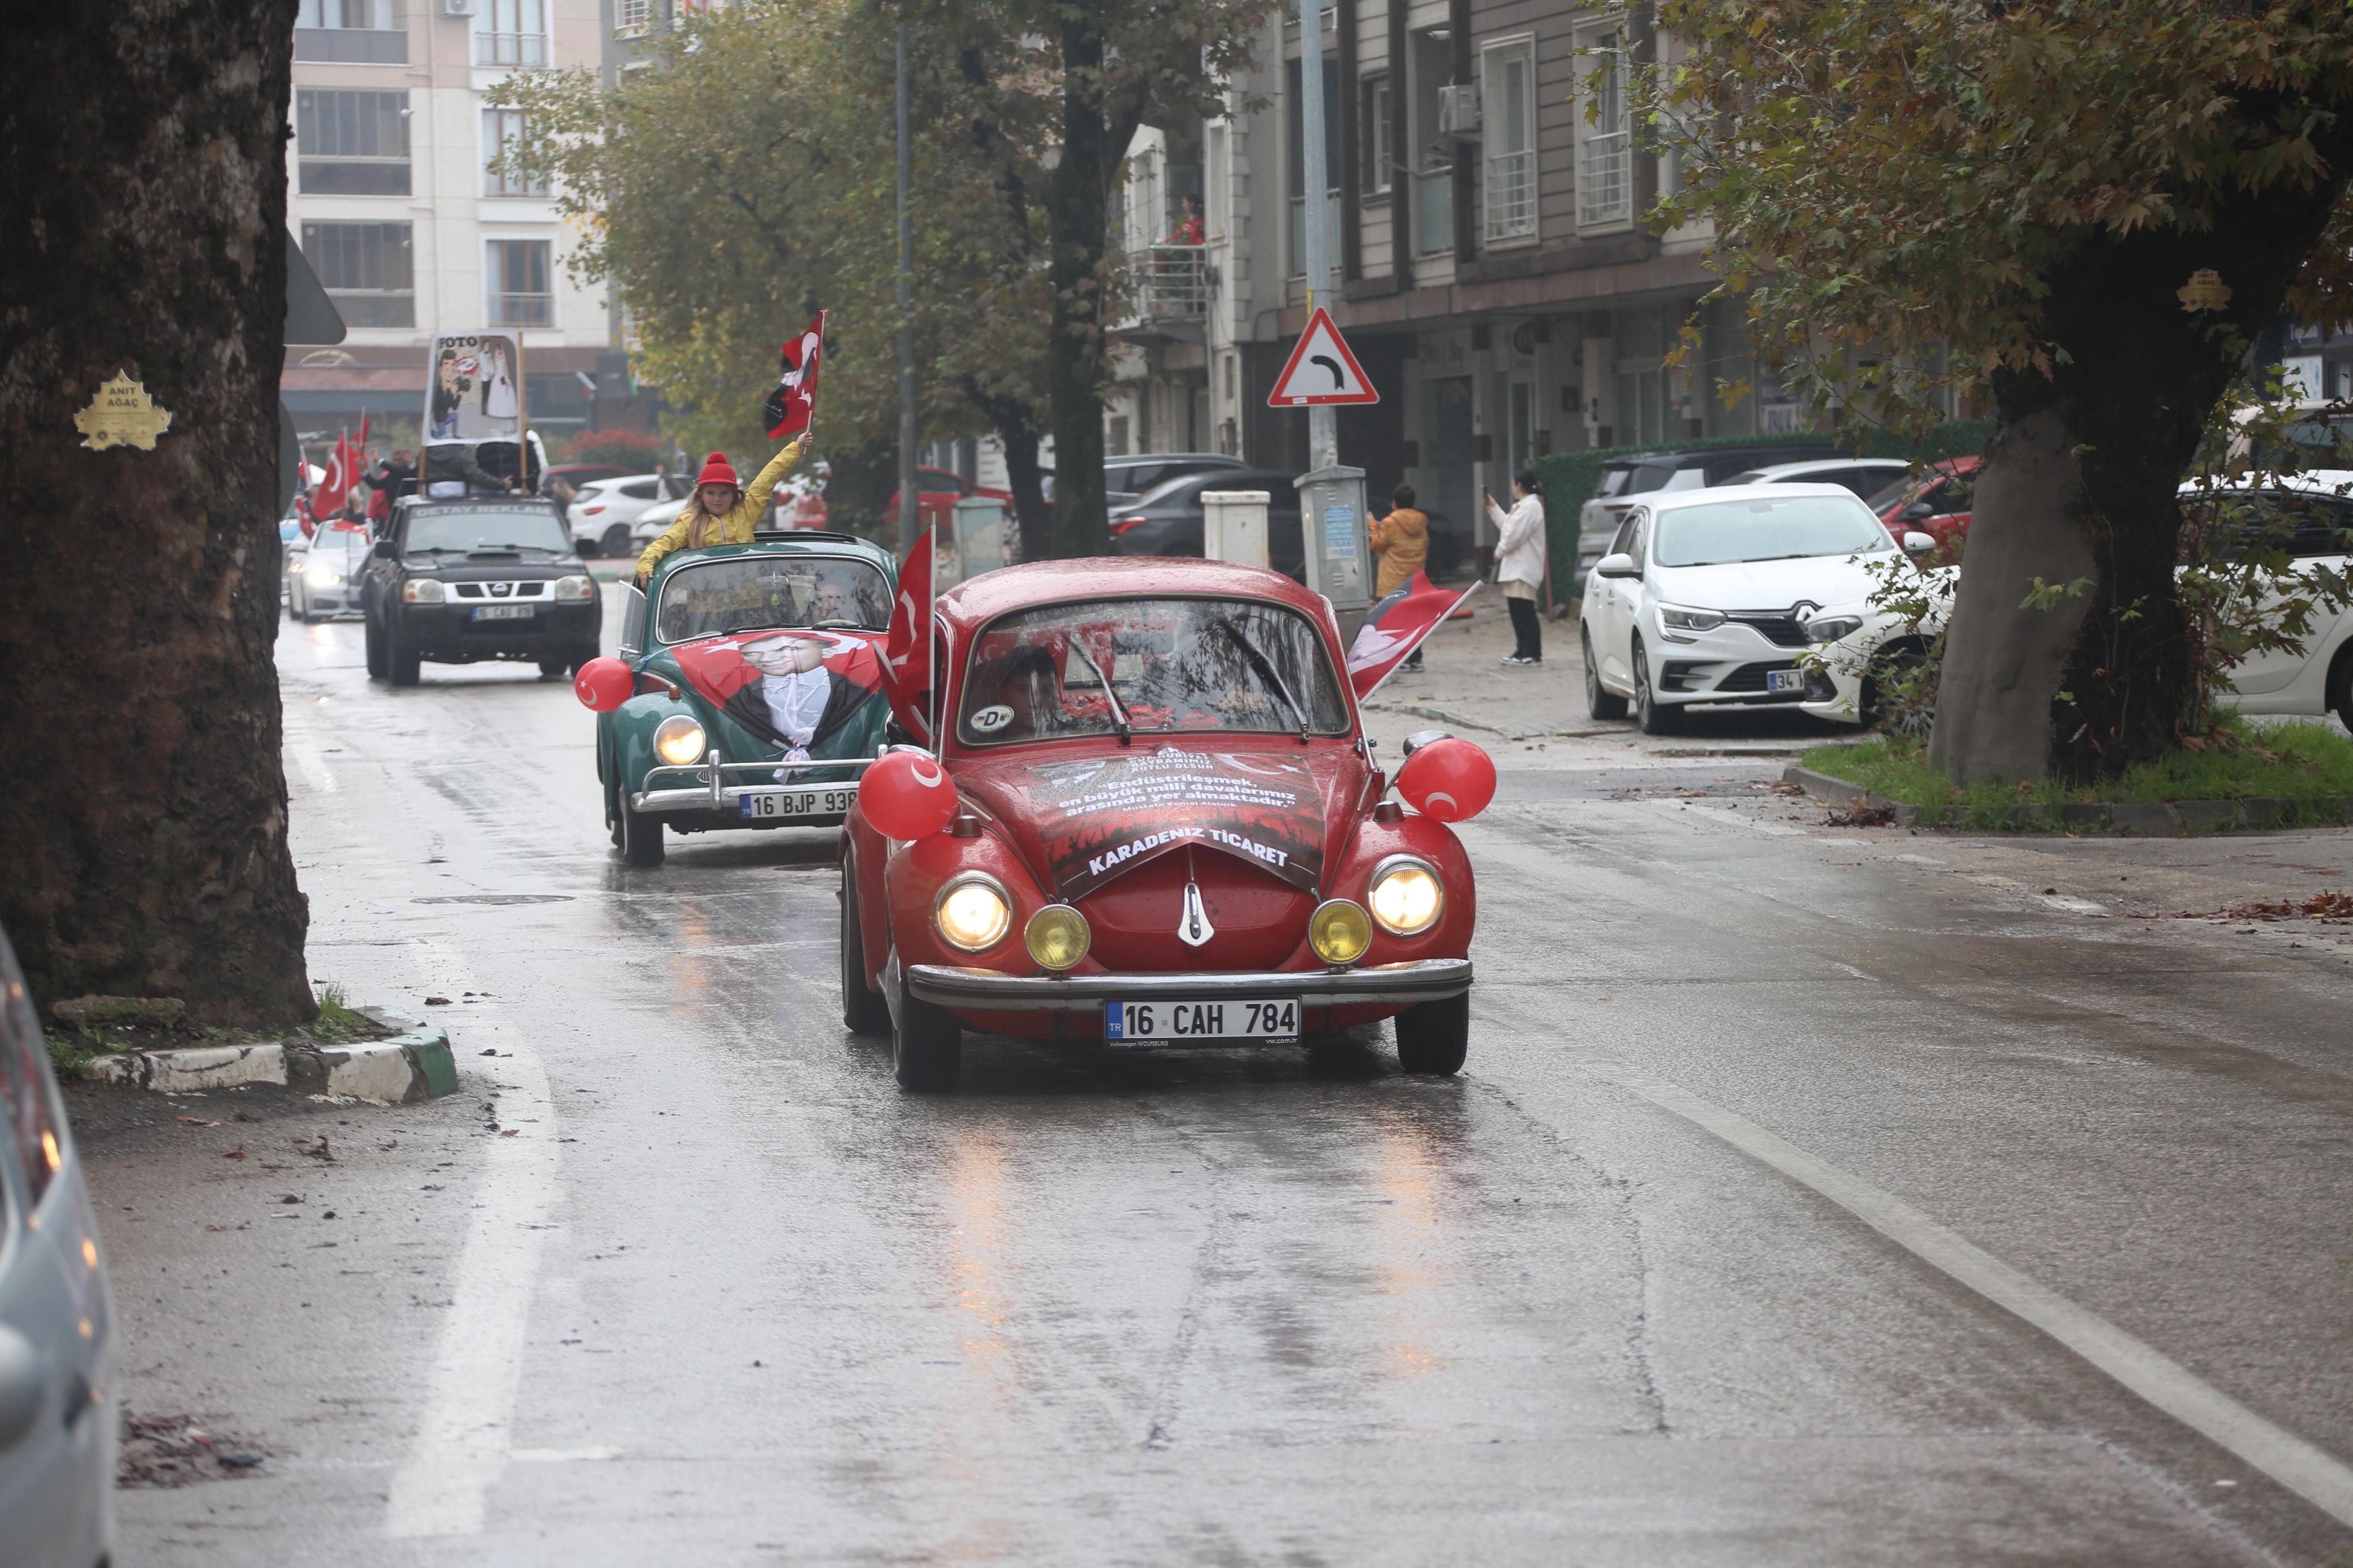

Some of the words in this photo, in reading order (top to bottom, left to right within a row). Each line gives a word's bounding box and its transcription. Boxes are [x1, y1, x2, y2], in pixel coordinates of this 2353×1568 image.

[439, 336, 477, 348] FOTO
[109, 387, 136, 395] ANIT
[107, 398, 139, 408] AĞAÇ
[416, 506, 472, 517] DETAY
[477, 505, 552, 515] REKLAM
[1778, 675, 1793, 688] 34
[984, 711, 999, 726] D
[1131, 758, 1211, 767] BAYRAMIMIZ
[1132, 764, 1169, 772] KUTLU
[1058, 798, 1081, 808] en
[1084, 787, 1143, 803] büyük
[1191, 783, 1296, 800] davalarımız
[754, 796, 774, 815] 16
[783, 794, 816, 814] BJP
[1067, 796, 1147, 816] arasında
[1151, 792, 1181, 802] yer
[1123, 803, 1164, 811] Mustafa
[1209, 829, 1287, 867] TİCARET
[1126, 1005, 1154, 1035] 16
[1174, 1004, 1223, 1035] CAH
[1246, 1003, 1295, 1034] 784
